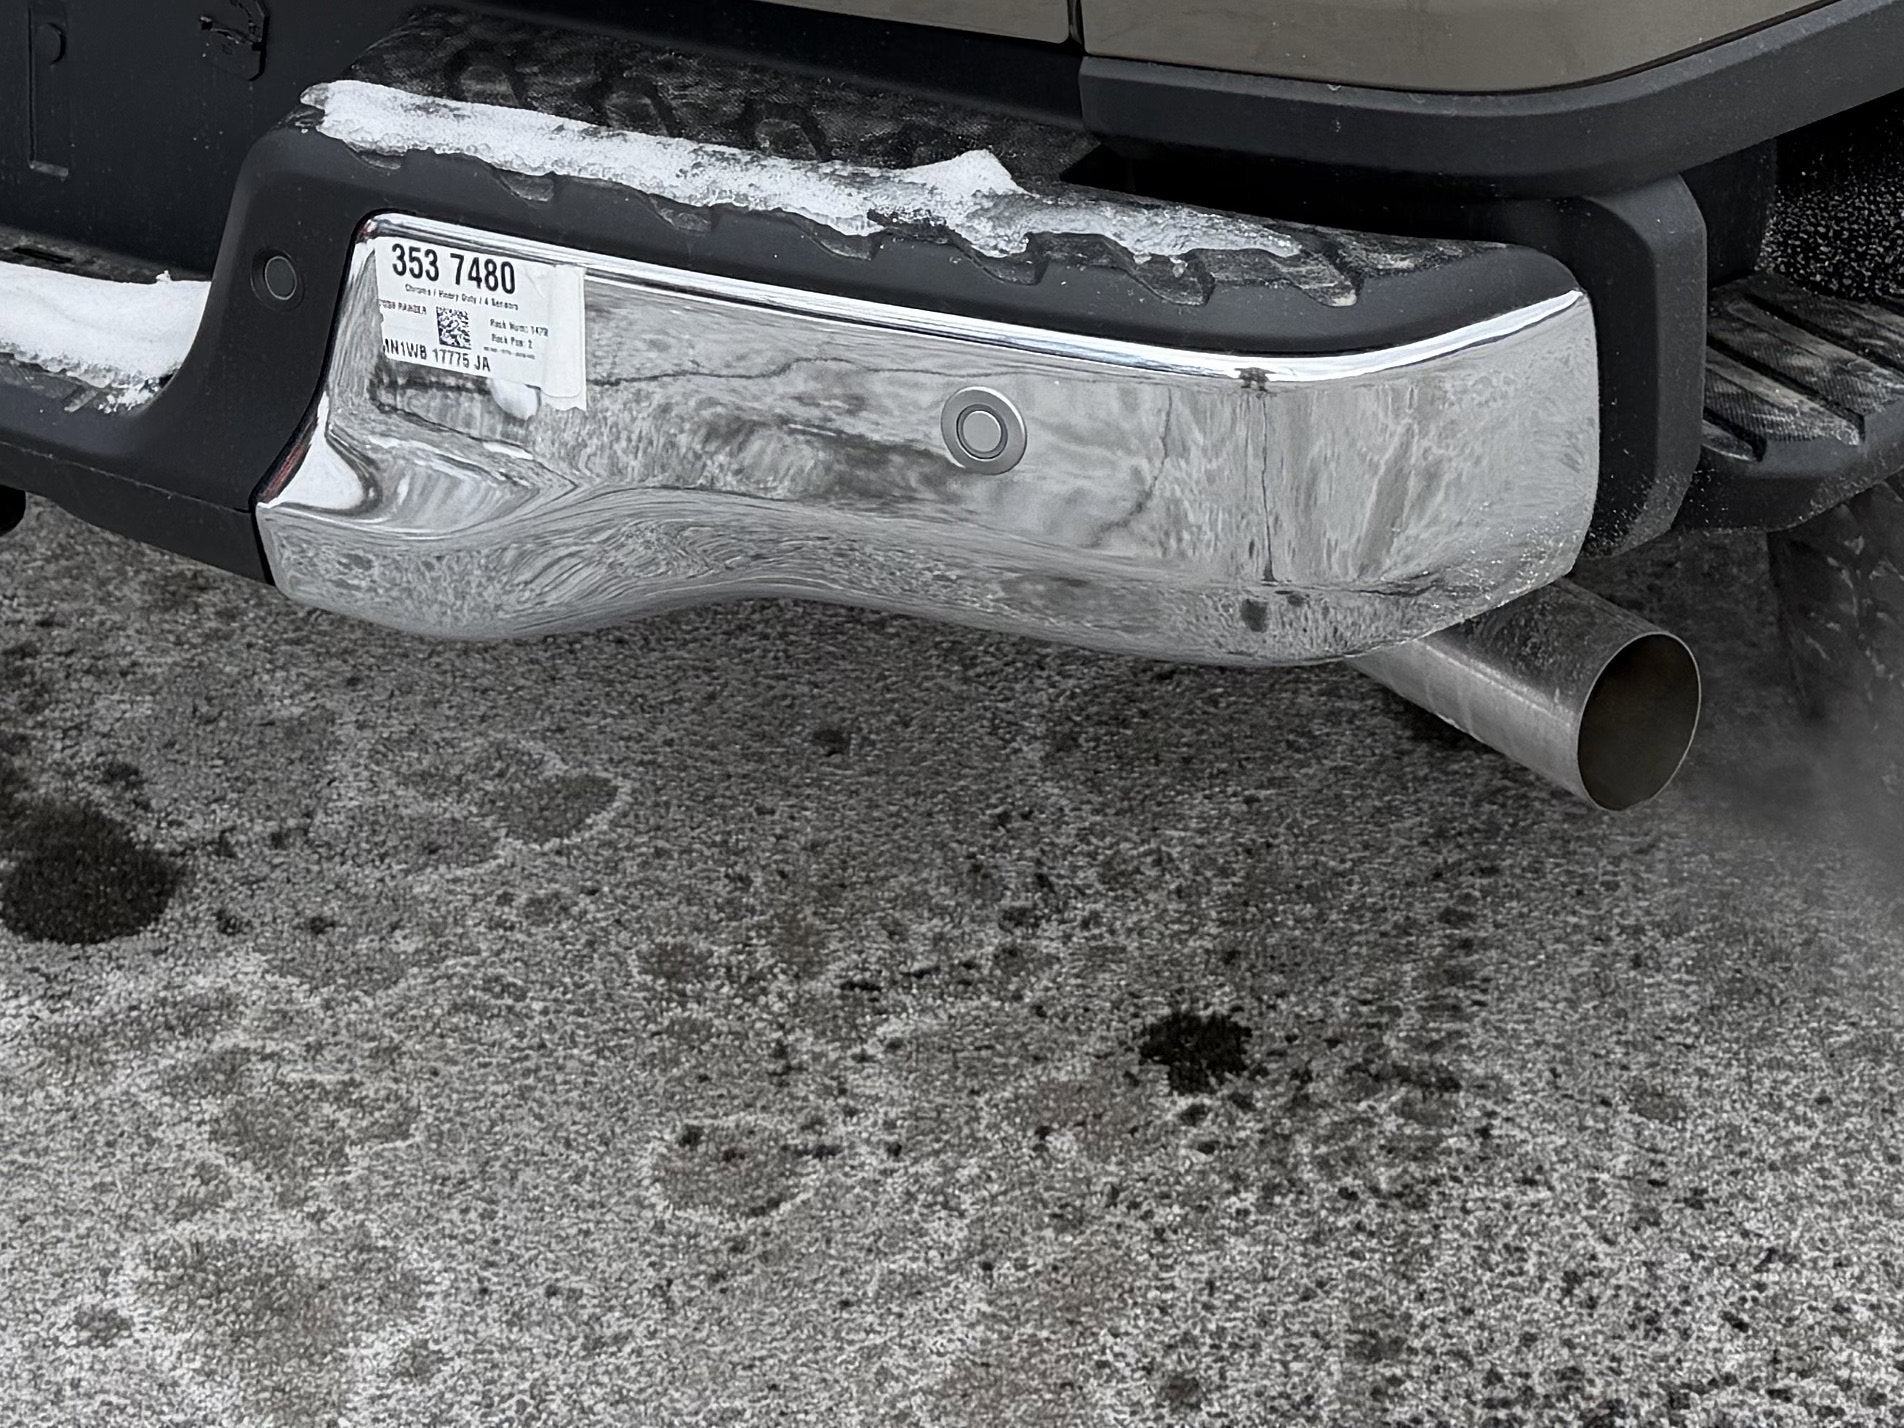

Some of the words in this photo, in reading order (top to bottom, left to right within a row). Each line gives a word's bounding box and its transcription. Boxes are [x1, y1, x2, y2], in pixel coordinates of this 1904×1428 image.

[391, 244, 439, 282] 353
[450, 253, 516, 295] 7480
[434, 349, 470, 369] 17775
[474, 354, 491, 372] JA
